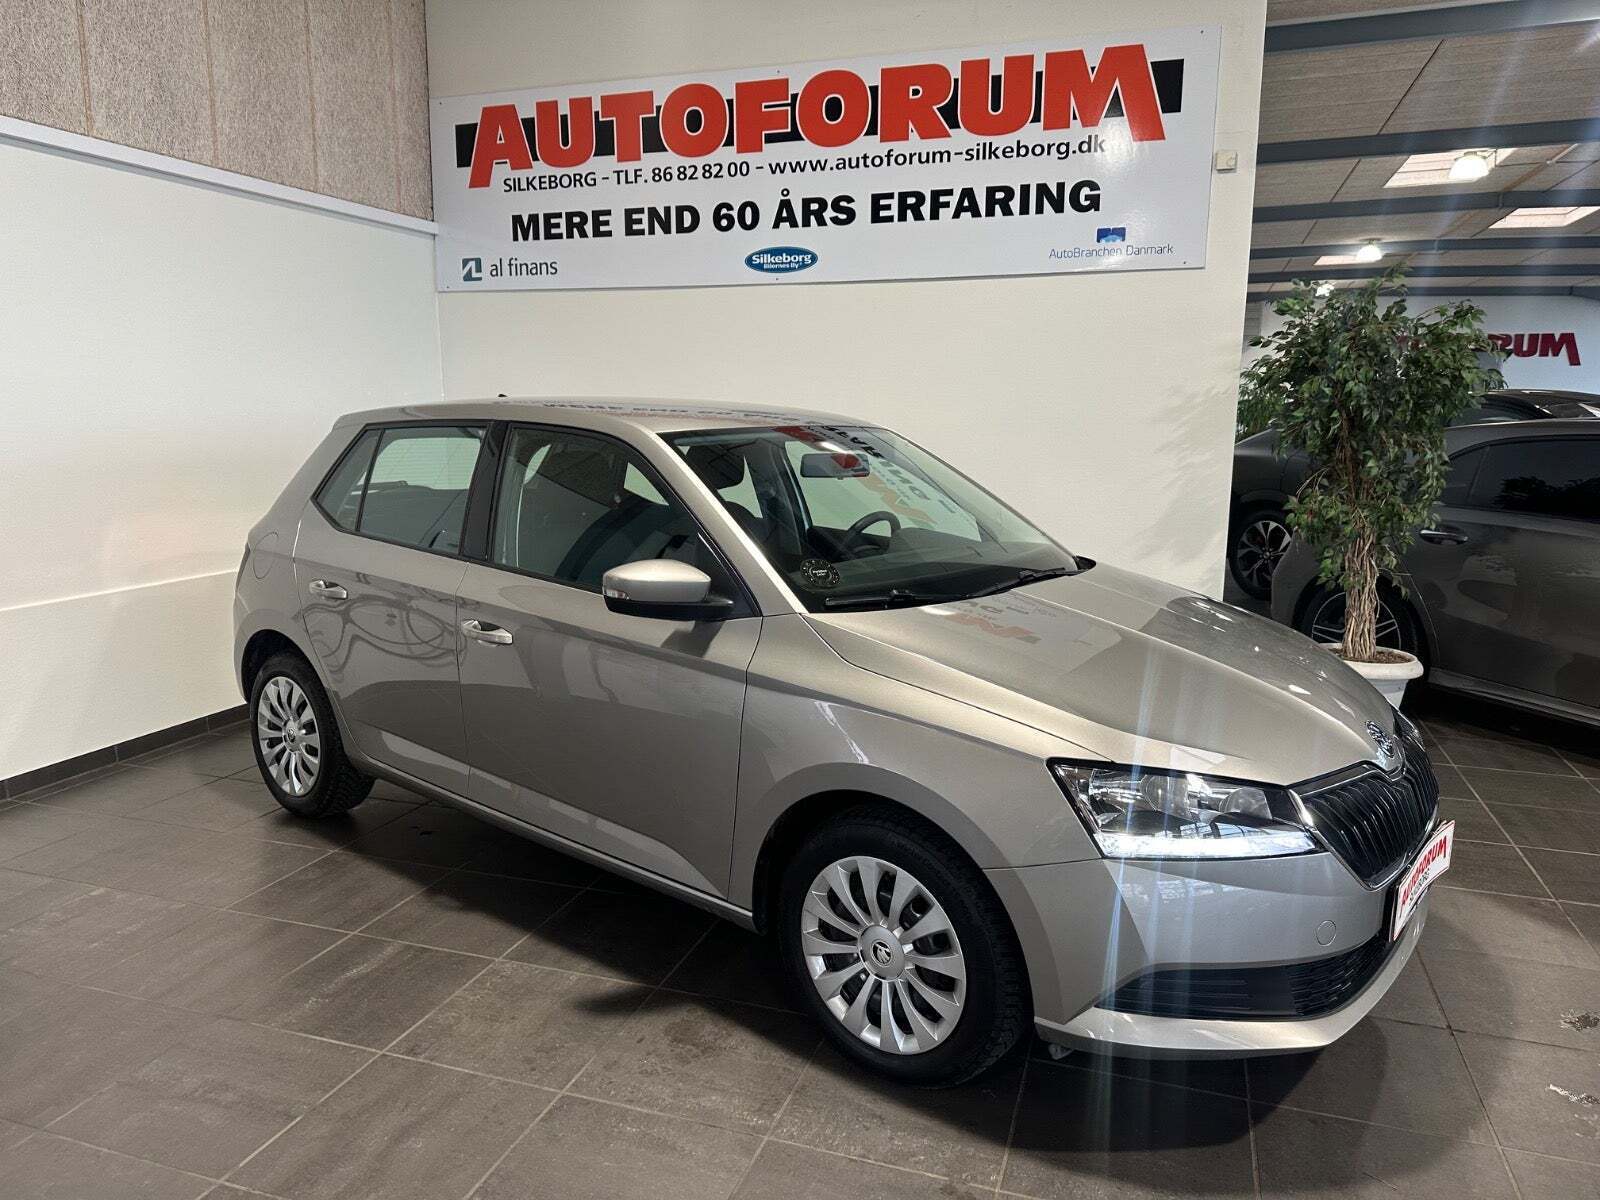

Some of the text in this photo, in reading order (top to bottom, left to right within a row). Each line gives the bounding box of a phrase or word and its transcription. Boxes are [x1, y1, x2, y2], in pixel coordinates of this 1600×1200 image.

[469, 44, 1166, 188] AUTOFORUM
[503, 171, 597, 193] SILKEBORG
[613, 168, 648, 186] TLF.
[652, 166, 674, 183] 86
[676, 165, 699, 182] 82
[702, 163, 724, 180] 82
[728, 161, 750, 178] 00
[768, 134, 1106, 175] www.autoforum-silkeborg.dk
[511, 178, 1102, 243] MERE END 60 ÅRS ERFARING
[490, 256, 558, 278] al finans
[752, 252, 812, 265] Silkeborg
[1048, 243, 1174, 259] AutoBranchen Danmark
